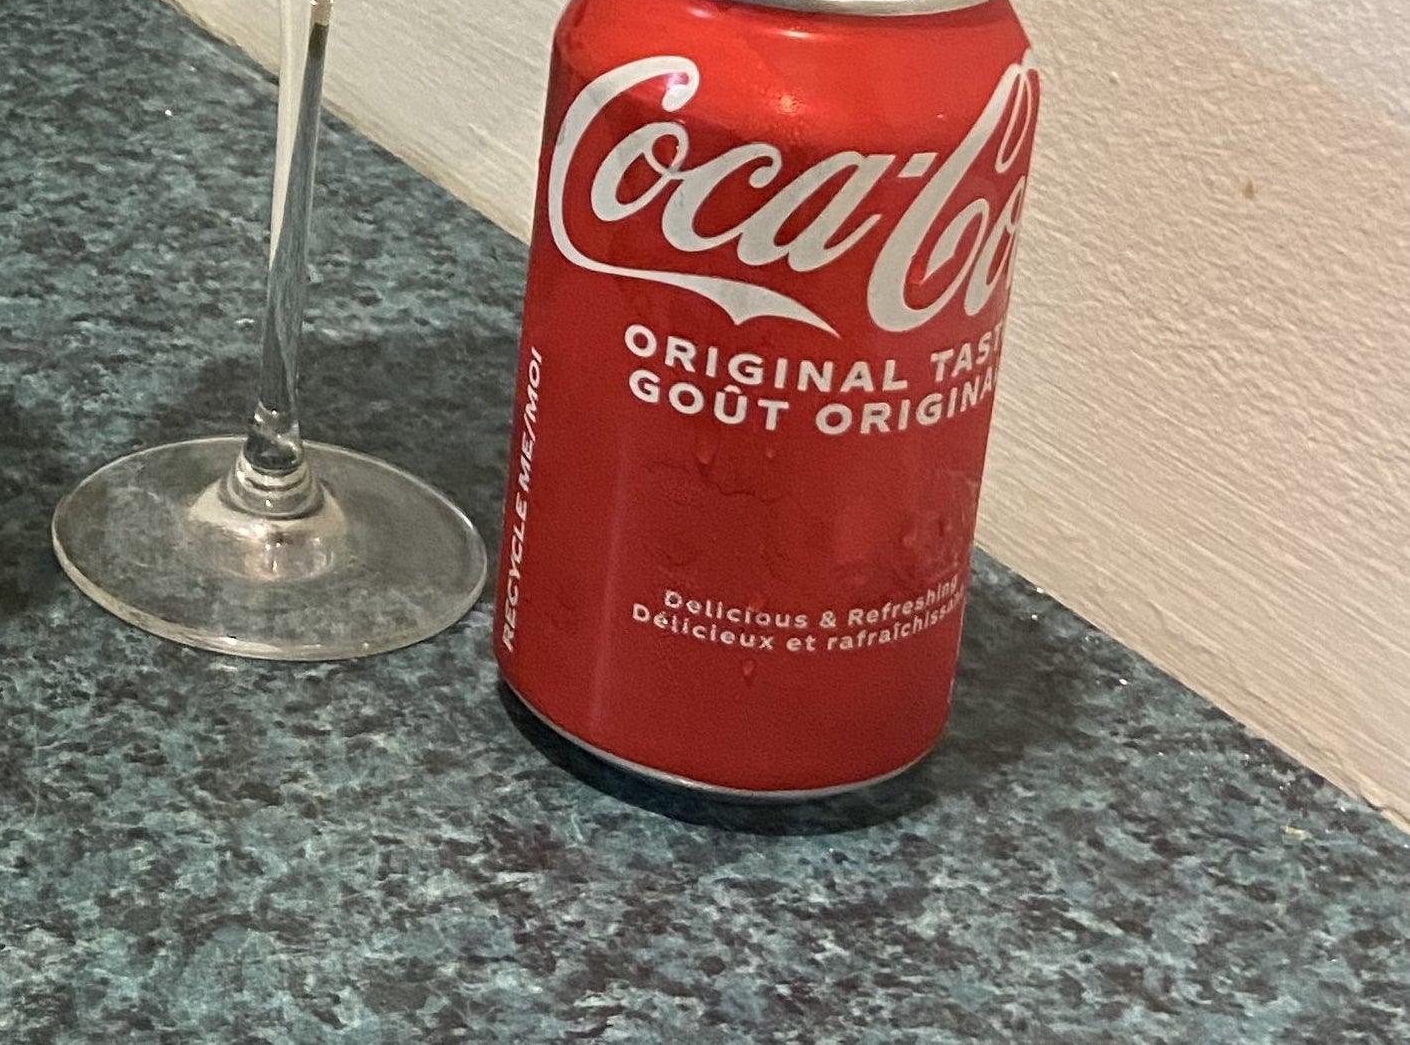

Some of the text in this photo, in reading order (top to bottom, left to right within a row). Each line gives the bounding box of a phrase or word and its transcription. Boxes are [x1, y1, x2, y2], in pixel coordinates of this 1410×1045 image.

[548, 48, 1031, 338] Coca-Co
[624, 319, 1003, 392] ORIGINAL TAST
[628, 369, 789, 431] GOÛT
[502, 346, 542, 652] RECYCLE ME/MOI
[633, 603, 774, 651] Délicieux
[786, 634, 816, 652] et
[664, 574, 958, 628] Delicious & Refreshing
